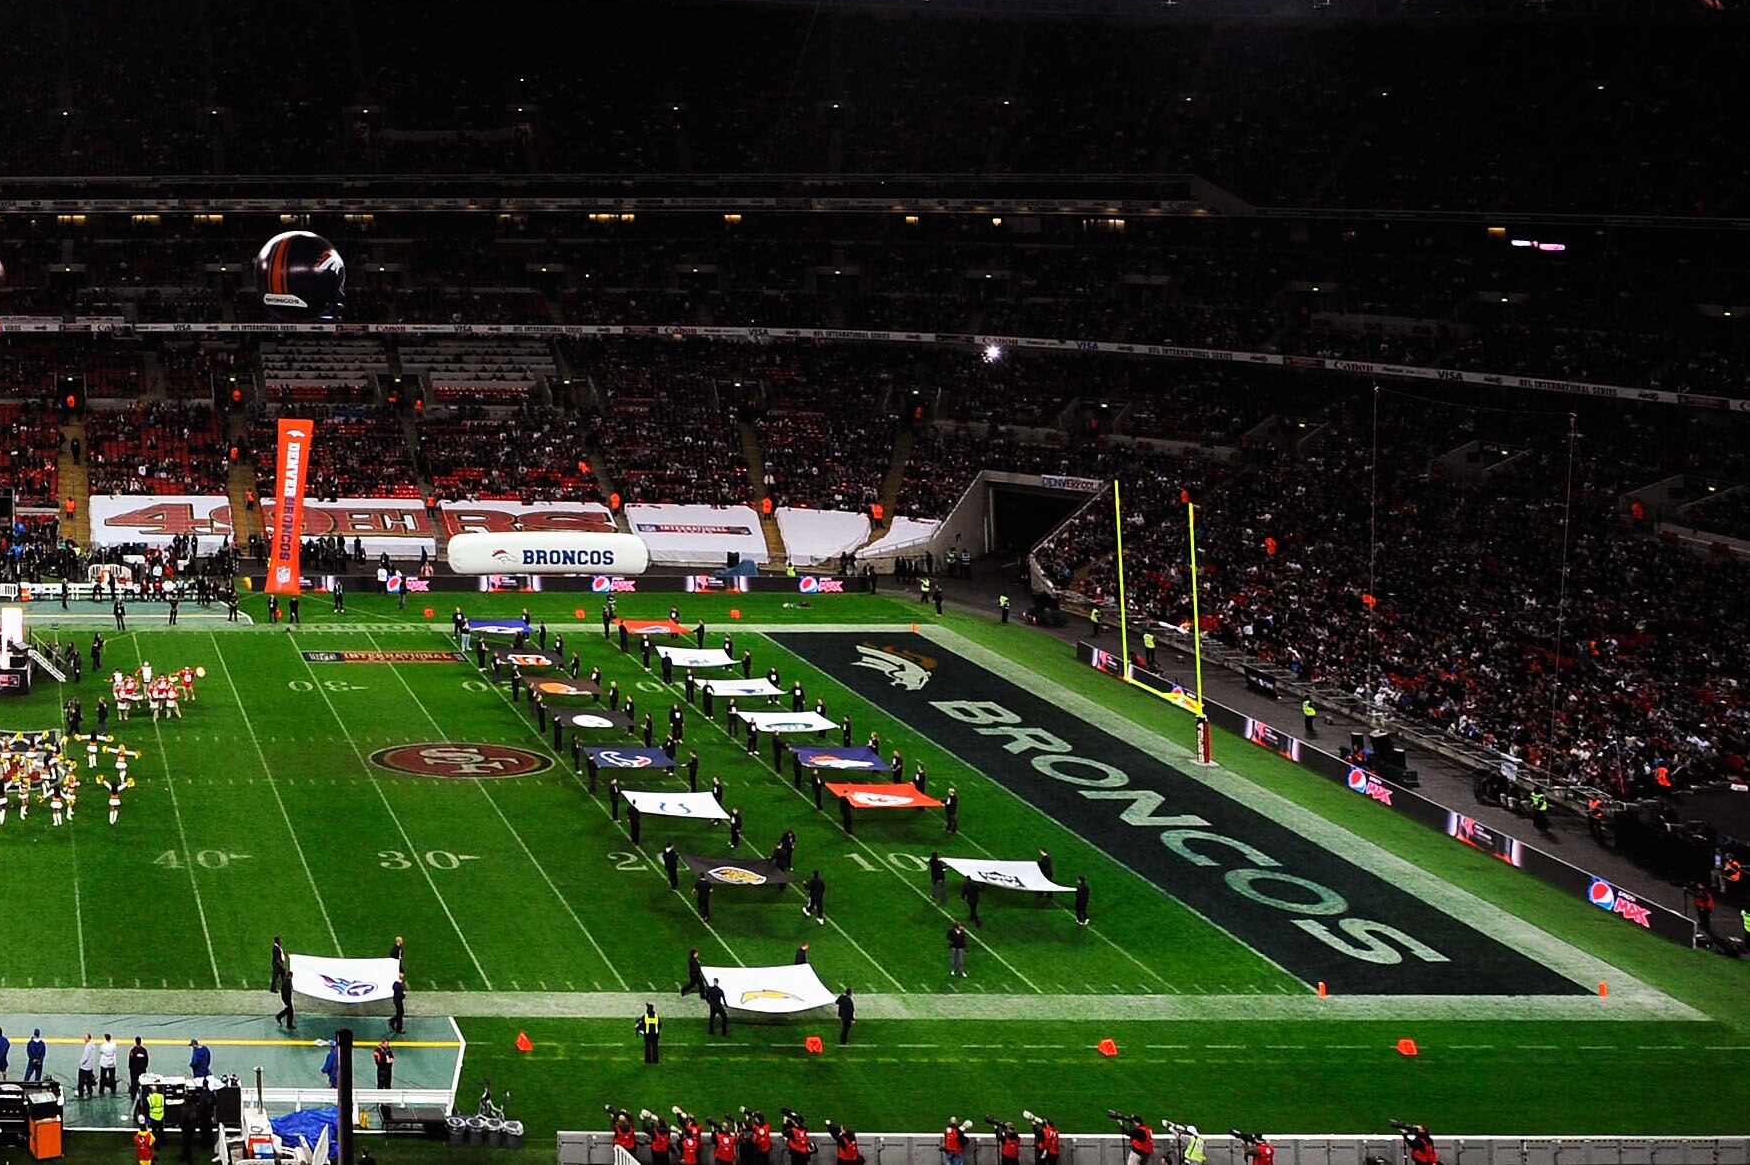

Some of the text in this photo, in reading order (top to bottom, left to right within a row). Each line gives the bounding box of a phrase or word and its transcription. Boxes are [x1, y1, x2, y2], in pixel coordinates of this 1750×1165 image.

[1076, 342, 1099, 350] VISA
[1334, 361, 1373, 372] Canon
[1438, 370, 1464, 381] VISA
[284, 442, 301, 496] DENVER
[279, 496, 295, 561] BRONCOS
[522, 549, 614, 565] BRONCOS
[1366, 782, 1393, 805] MAX
[927, 700, 1451, 966] BRONCOS
[154, 850, 229, 869] 40
[378, 851, 461, 870] 30
[843, 852, 929, 872] 10
[1614, 897, 1651, 928] MAX
